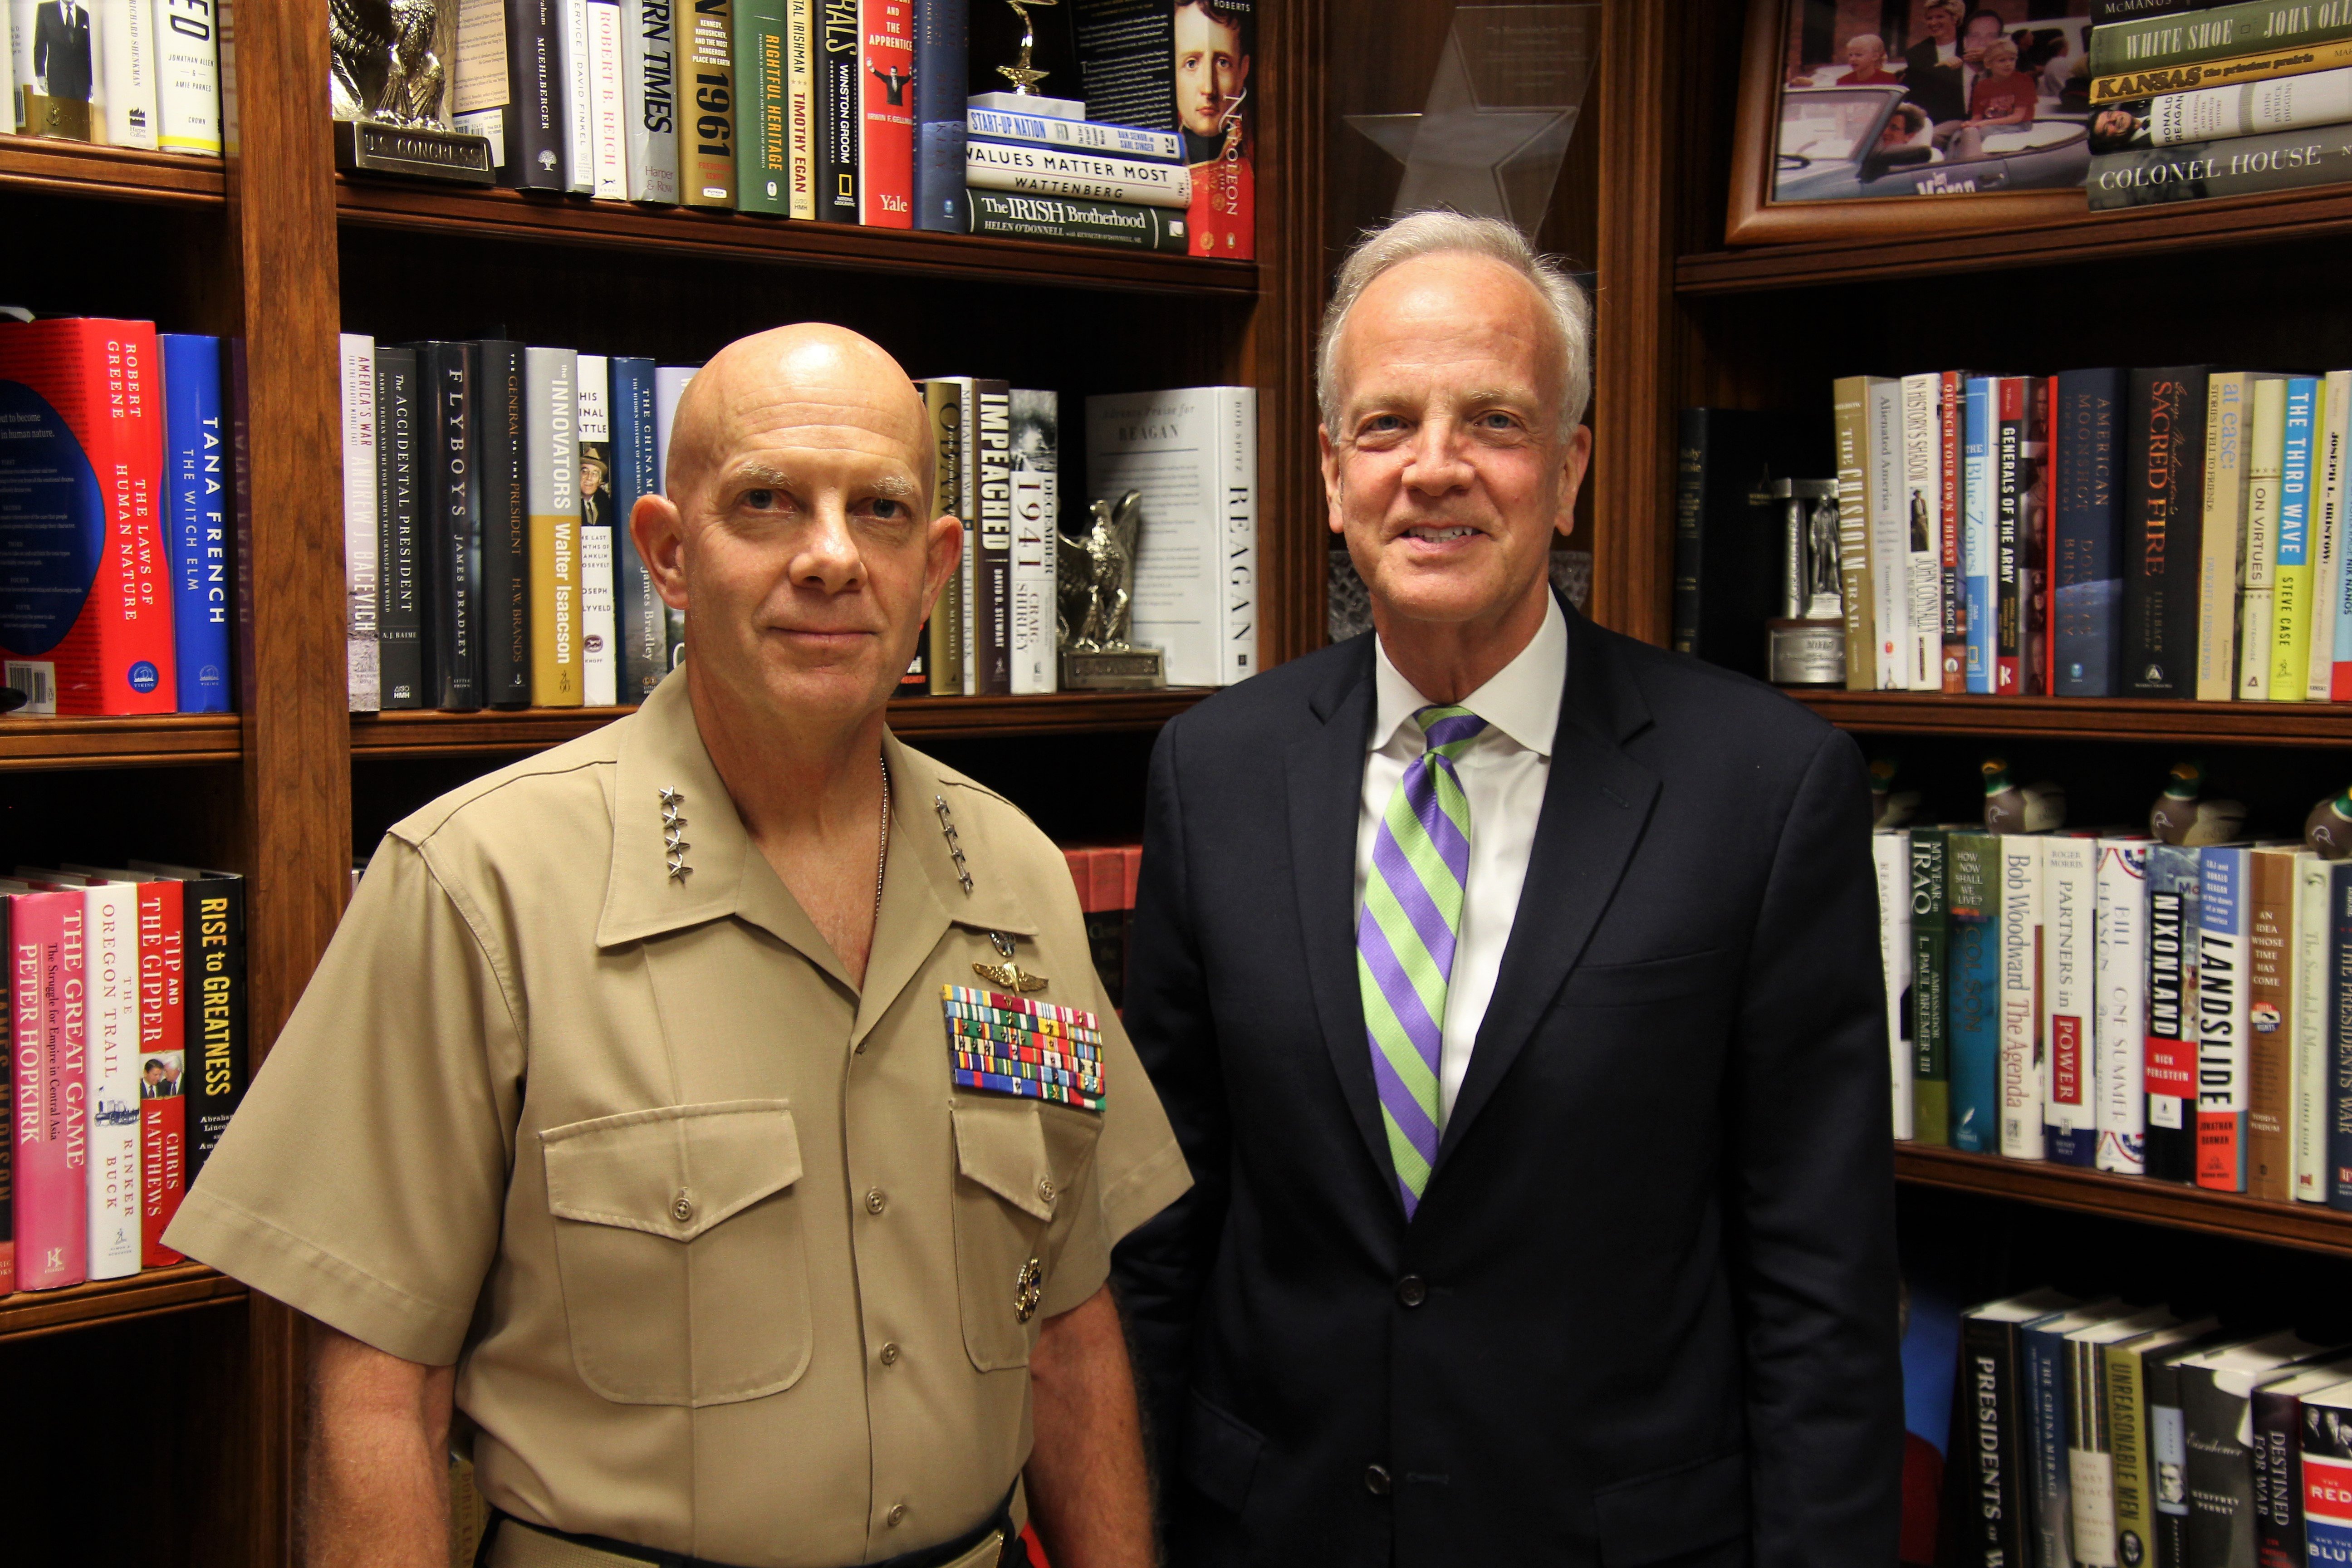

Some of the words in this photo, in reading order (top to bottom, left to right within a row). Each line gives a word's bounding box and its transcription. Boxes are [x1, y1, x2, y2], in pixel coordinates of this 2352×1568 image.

[886, 21, 900, 34] THE
[887, 6, 900, 16] AND
[168, 54, 198, 64] JONATHAN
[200, 59, 215, 67] ALLEN
[692, 55, 709, 64] PLACE
[717, 58, 730, 67] EARTH
[699, 47, 726, 57] DANGEROUS
[765, 34, 781, 100] RIGHTFUL
[176, 80, 190, 89] AMIE
[192, 83, 211, 92] PARNES
[537, 37, 549, 130] MUEHLBERGER
[839, 64, 850, 118] WINSTON
[2285, 83, 2293, 122] DIGGINS
[188, 116, 206, 125] CROWN
[696, 72, 731, 157] 1961
[767, 105, 783, 171] HERITAGE
[794, 92, 806, 152] TIMOTHY
[2162, 96, 2173, 143] RONALD
[2175, 95, 2185, 142] REAGAN
[840, 121, 850, 164] GROOM
[2099, 159, 2221, 191] COLONEL
[2230, 145, 2322, 176] HOUSE
[645, 165, 674, 180] Harper
[647, 181, 654, 190] &
[657, 181, 674, 193] Row
[795, 157, 807, 193] EGAN
[1014, 176, 1124, 199] WATTENBERG
[879, 194, 907, 213] Yale
[981, 196, 1009, 214] The
[1006, 197, 1066, 224] IRISH
[1065, 205, 1147, 230] Brotherhood
[108, 341, 124, 419] GREENE
[125, 343, 142, 417] ROBERT
[358, 356, 371, 417] AMERICA'S
[395, 374, 404, 392] The
[642, 389, 650, 419] THE
[508, 376, 519, 438] GENERAL
[1118, 424, 1180, 441] REAGAN
[1880, 396, 1891, 457] Alienated
[1945, 383, 1955, 438] QUENCH
[2288, 393, 2309, 427] THE
[203, 417, 221, 495] TANA
[360, 423, 372, 446] WAR
[396, 395, 410, 507] ACCIDENTAL
[449, 369, 466, 516] FLYBOYS
[551, 380, 572, 510] INNOVATORS
[643, 425, 653, 474] CHINA
[1841, 428, 1852, 466] THE
[1945, 442, 1955, 476] YOUR
[2094, 397, 2111, 505] AMERICAN
[2148, 381, 2172, 490] SACRED
[980, 393, 1010, 550] IMPEACHED
[1881, 459, 1891, 511] America
[2001, 427, 2016, 494] GENERALS
[2284, 437, 2307, 493] THIRD
[116, 464, 132, 536] HUMAN
[510, 483, 522, 556] PRESIDENT
[1838, 467, 1866, 570] CHISHOLM
[1945, 481, 1955, 513] OWN
[2001, 497, 2015, 514] OF
[2255, 488, 2265, 513] ON
[1017, 479, 1042, 570] 1941
[1044, 479, 1054, 574] DECEMBER
[1944, 517, 1955, 563] THIRST
[2001, 519, 2014, 543] THE
[2144, 499, 2167, 576] FIRE
[2251, 516, 2264, 580] VIRTUES
[2280, 504, 2304, 554] WAVE
[206, 512, 225, 623] FRENCH
[398, 514, 413, 612] PRESIDENT
[454, 534, 465, 582] JAMES
[555, 523, 572, 581] Walter
[1229, 487, 1252, 641] REAGAN
[2000, 547, 2015, 584] ARMY
[121, 544, 137, 620] NATURE
[640, 566, 651, 607] James
[1847, 576, 1860, 633] TRAIL
[2280, 577, 2293, 612] STEVE
[456, 590, 466, 657] BRADLEY
[556, 585, 572, 664] Isaacson
[642, 610, 656, 661] Bradley
[1016, 583, 1029, 654] SHIRLEY
[1029, 593, 1040, 643] CRAIG
[2279, 615, 2291, 647] CASE
[1911, 841, 1931, 915] IRAQ
[1955, 874, 1983, 885] SHALL
[1958, 852, 1979, 862] HOW
[1960, 863, 1981, 873] NOW
[2008, 854, 2032, 889] Bob
[2050, 860, 2083, 868] MORRIS
[2052, 851, 2081, 859] ROGER
[1960, 886, 1975, 894] WE
[2259, 911, 2273, 920] AN
[63, 910, 82, 971] THE
[142, 897, 161, 947] THE
[2007, 894, 2030, 991] Woodward
[2059, 880, 2073, 985] PARTNERS
[2251, 936, 2284, 948] WHOSE
[2256, 924, 2278, 934] IDEA
[103, 904, 116, 999] OREGON
[165, 931, 181, 972] TIP
[2152, 895, 2179, 1035] NIXONLAND
[2255, 950, 2278, 960] TIME
[2257, 963, 2275, 973] HAS
[19, 943, 38, 1024] PETER
[142, 954, 162, 1043] GIPPER
[168, 978, 179, 1005] AND
[1964, 926, 1982, 1032] COLSON
[2059, 990, 2073, 1008] in
[2253, 976, 2280, 987] COME
[64, 979, 83, 1074] GREAT
[104, 1008, 118, 1078] TRAIL
[2007, 1000, 2030, 1035] The
[2200, 935, 2234, 1105] LANDSLIDE
[2001, 1037, 2030, 1107] Agenda
[2058, 1020, 2074, 1099] POWER
[20, 1029, 39, 1145] HOPKIRK
[65, 1082, 85, 1170] GAME
[107, 1156, 117, 1209] BUCK
[124, 1139, 134, 1217] RINKER
[147, 1110, 162, 1217] MATTHEWS
[166, 1132, 180, 1191] CHRIS
[2111, 1362, 2138, 1482] UNREASONABLE
[2254, 1434, 2266, 1476] FOR
[2270, 1430, 2290, 1527] DESTINED
[2117, 1485, 2140, 1521] MEN
[2191, 1490, 2240, 1506] GEOFFREY
[2255, 1476, 2270, 1517] WAR
